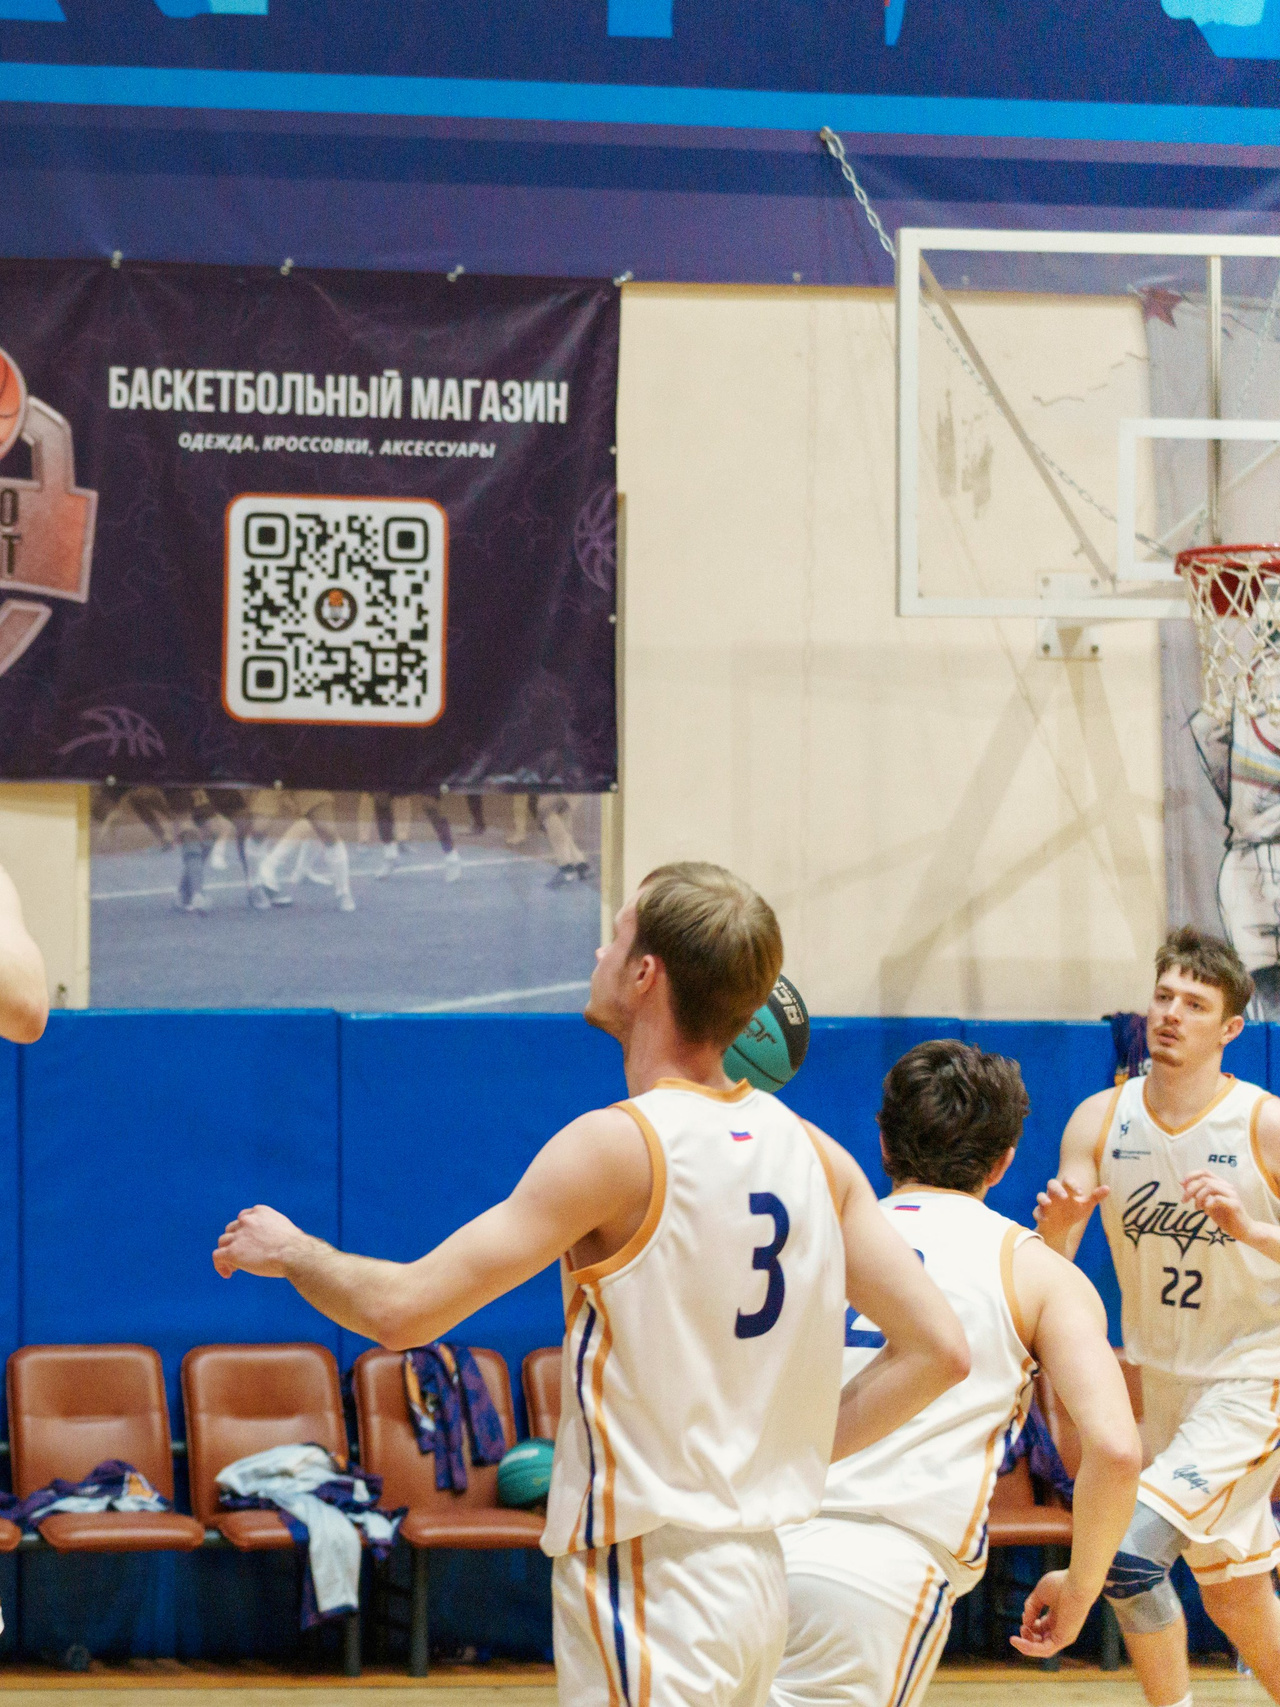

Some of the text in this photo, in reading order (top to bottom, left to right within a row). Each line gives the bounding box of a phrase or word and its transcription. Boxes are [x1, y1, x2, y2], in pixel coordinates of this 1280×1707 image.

[108, 366, 569, 424] БАСКЕТБОЛЬНЫЙ МАГАЗИН
[178, 432, 496, 459] ОДЕЖДА, КРОССОВКИ, АКСЕССУАРЫ
[734, 1192, 790, 1339] 3
[1161, 1266, 1203, 1310] 22
